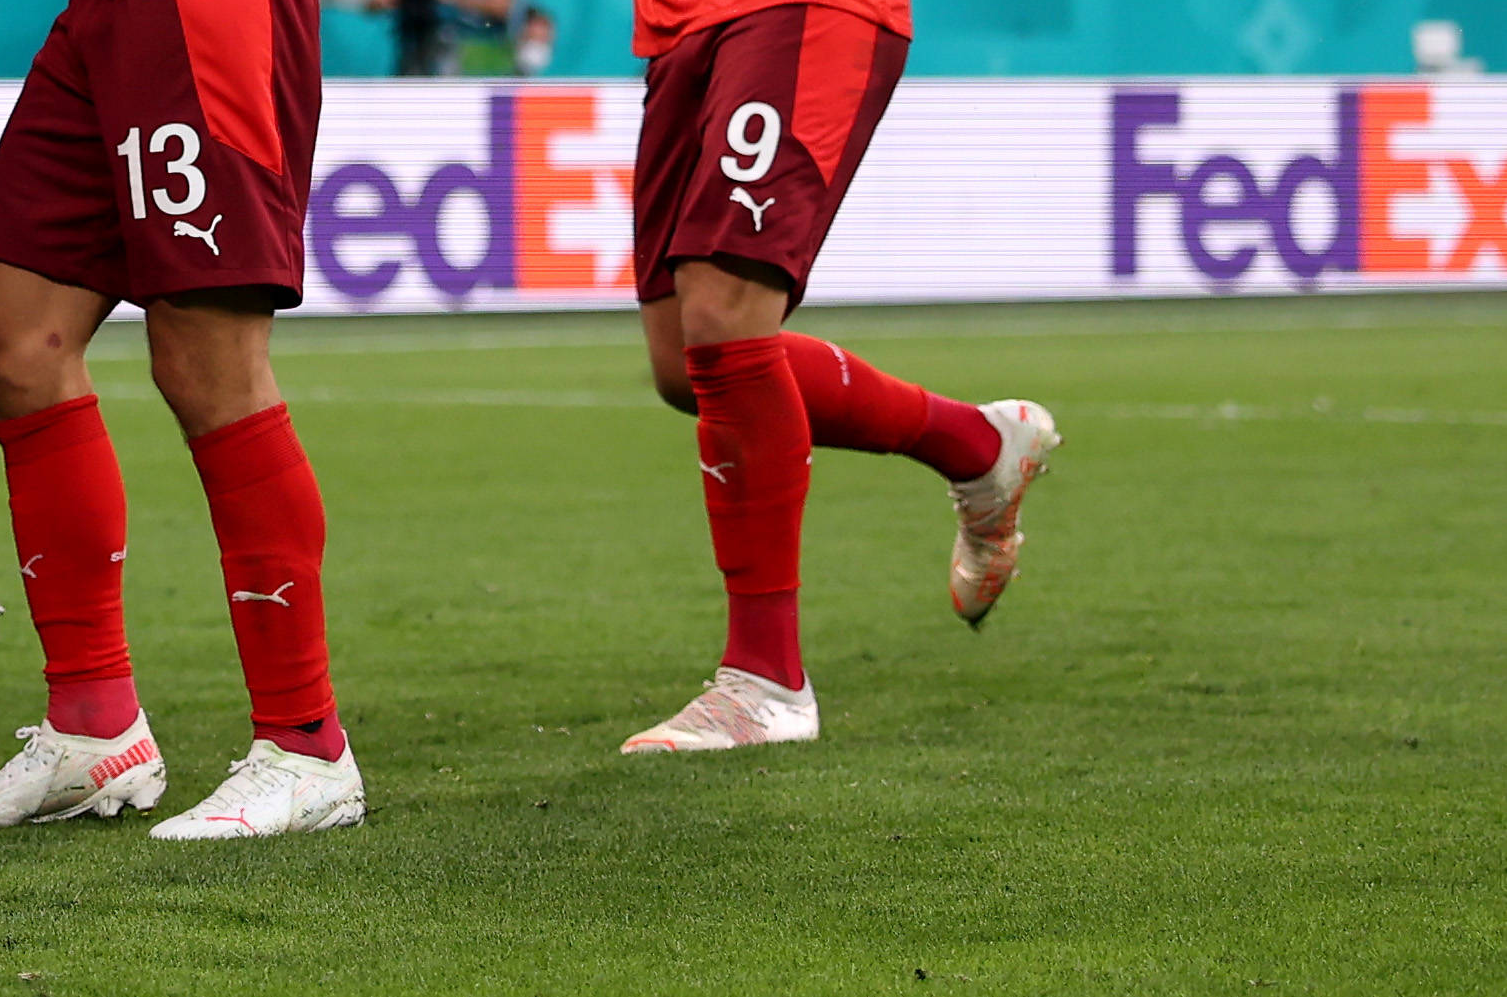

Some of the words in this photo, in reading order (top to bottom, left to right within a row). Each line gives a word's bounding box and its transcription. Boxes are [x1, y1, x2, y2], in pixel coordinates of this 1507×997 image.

[117, 122, 206, 219] 13
[306, 89, 637, 298] edE
[720, 102, 781, 182] 9
[1111, 84, 1507, 282] FedEx
